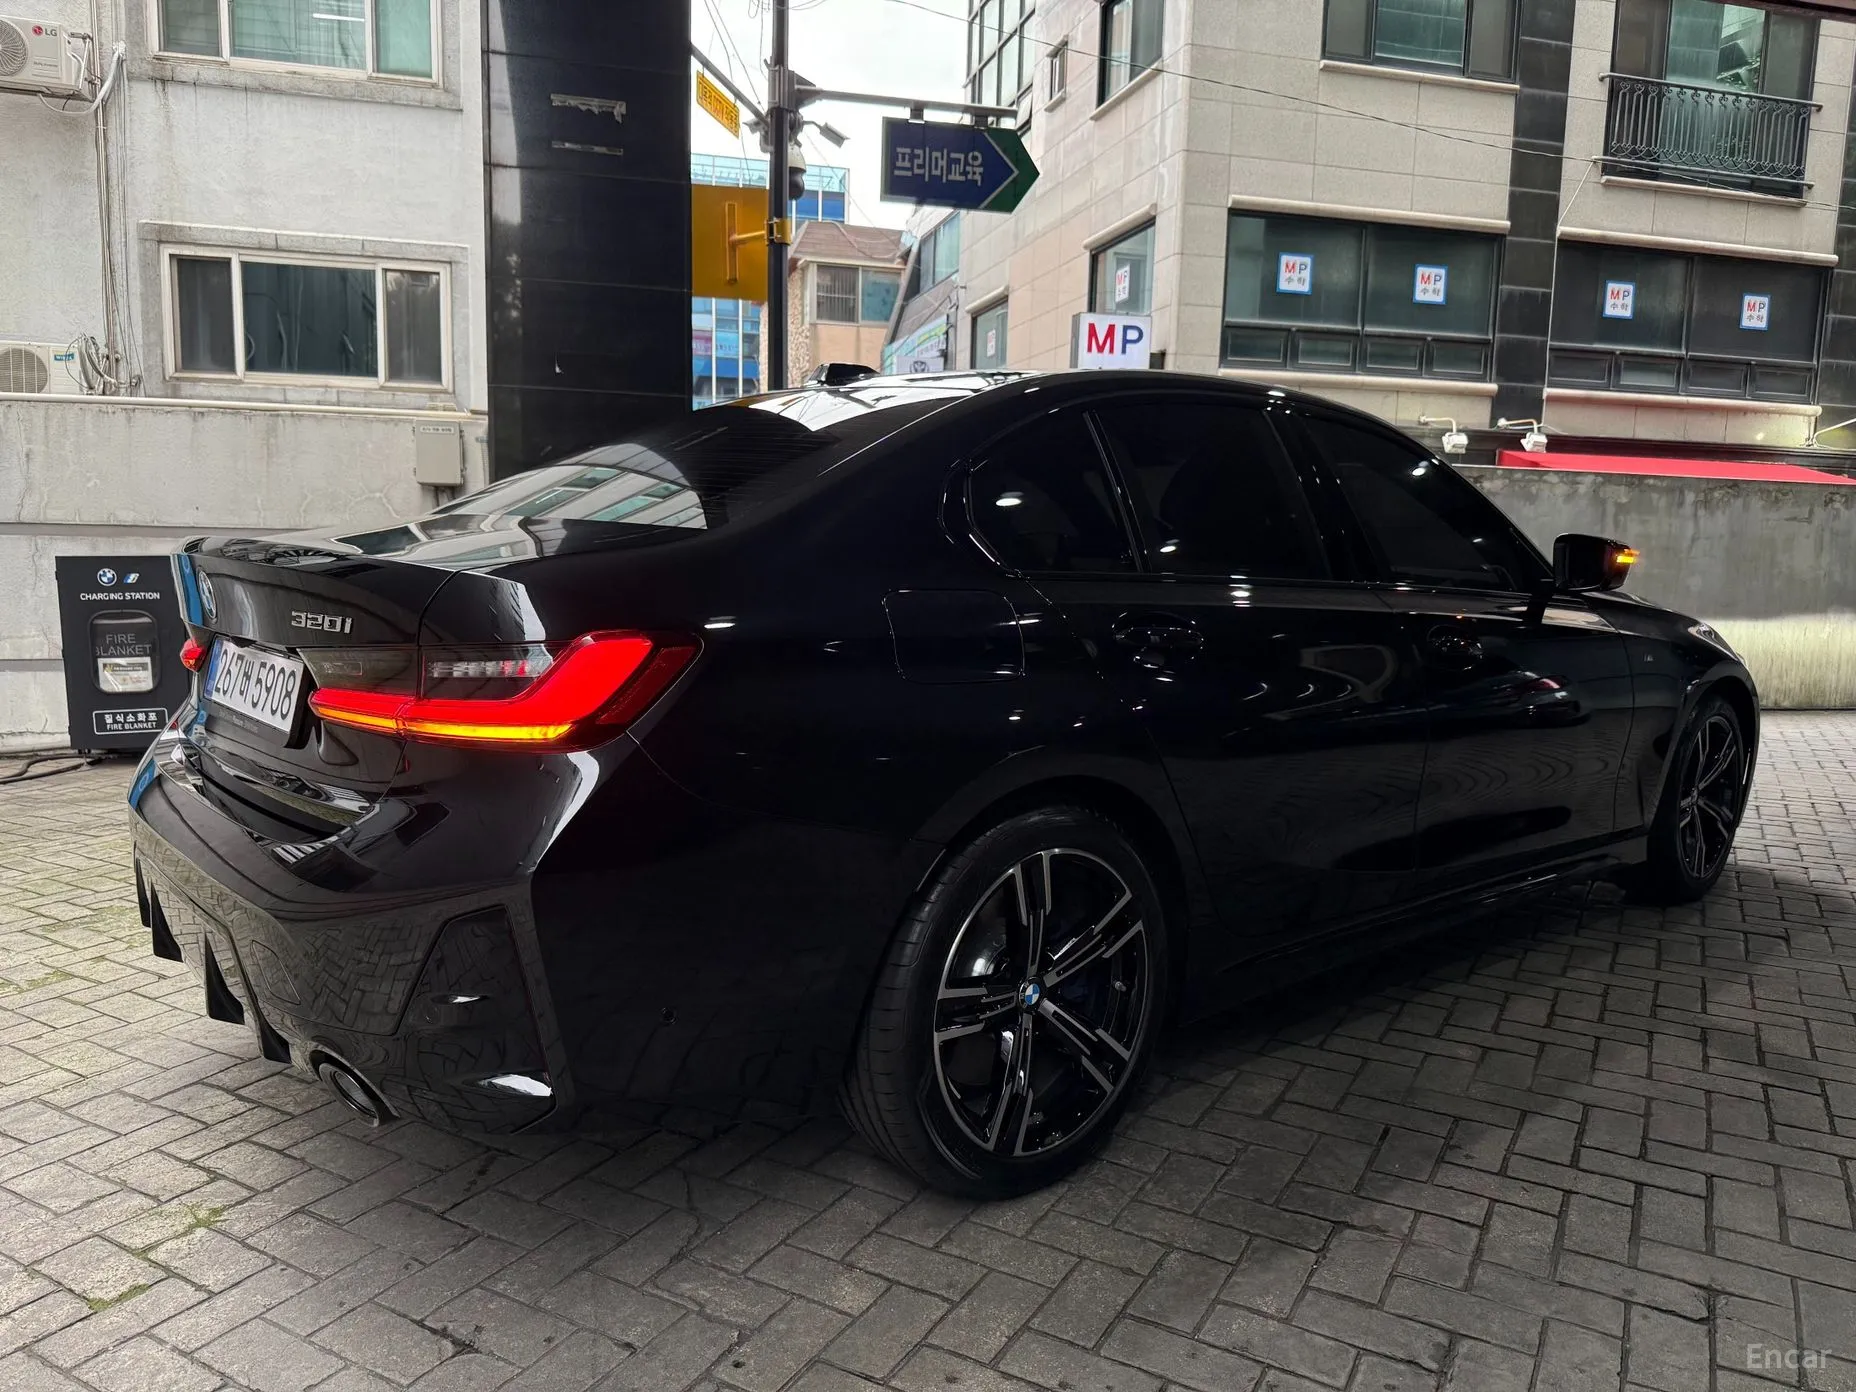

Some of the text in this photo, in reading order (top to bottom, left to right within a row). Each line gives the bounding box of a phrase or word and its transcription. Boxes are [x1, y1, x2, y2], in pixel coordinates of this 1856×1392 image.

[45, 28, 58, 37] LG
[893, 146, 984, 187] 프리머교육
[1284, 260, 1308, 275] MP
[1420, 271, 1443, 286] MP
[1610, 288, 1631, 301] MP
[1747, 300, 1766, 313] MP
[1087, 322, 1144, 355] MP
[80, 591, 160, 601] CHARGING STATION
[291, 611, 353, 634] 320i
[106, 633, 136, 644] FIRE
[104, 712, 158, 724] 질식소화포
[106, 721, 157, 731] FIRE BLANKET
